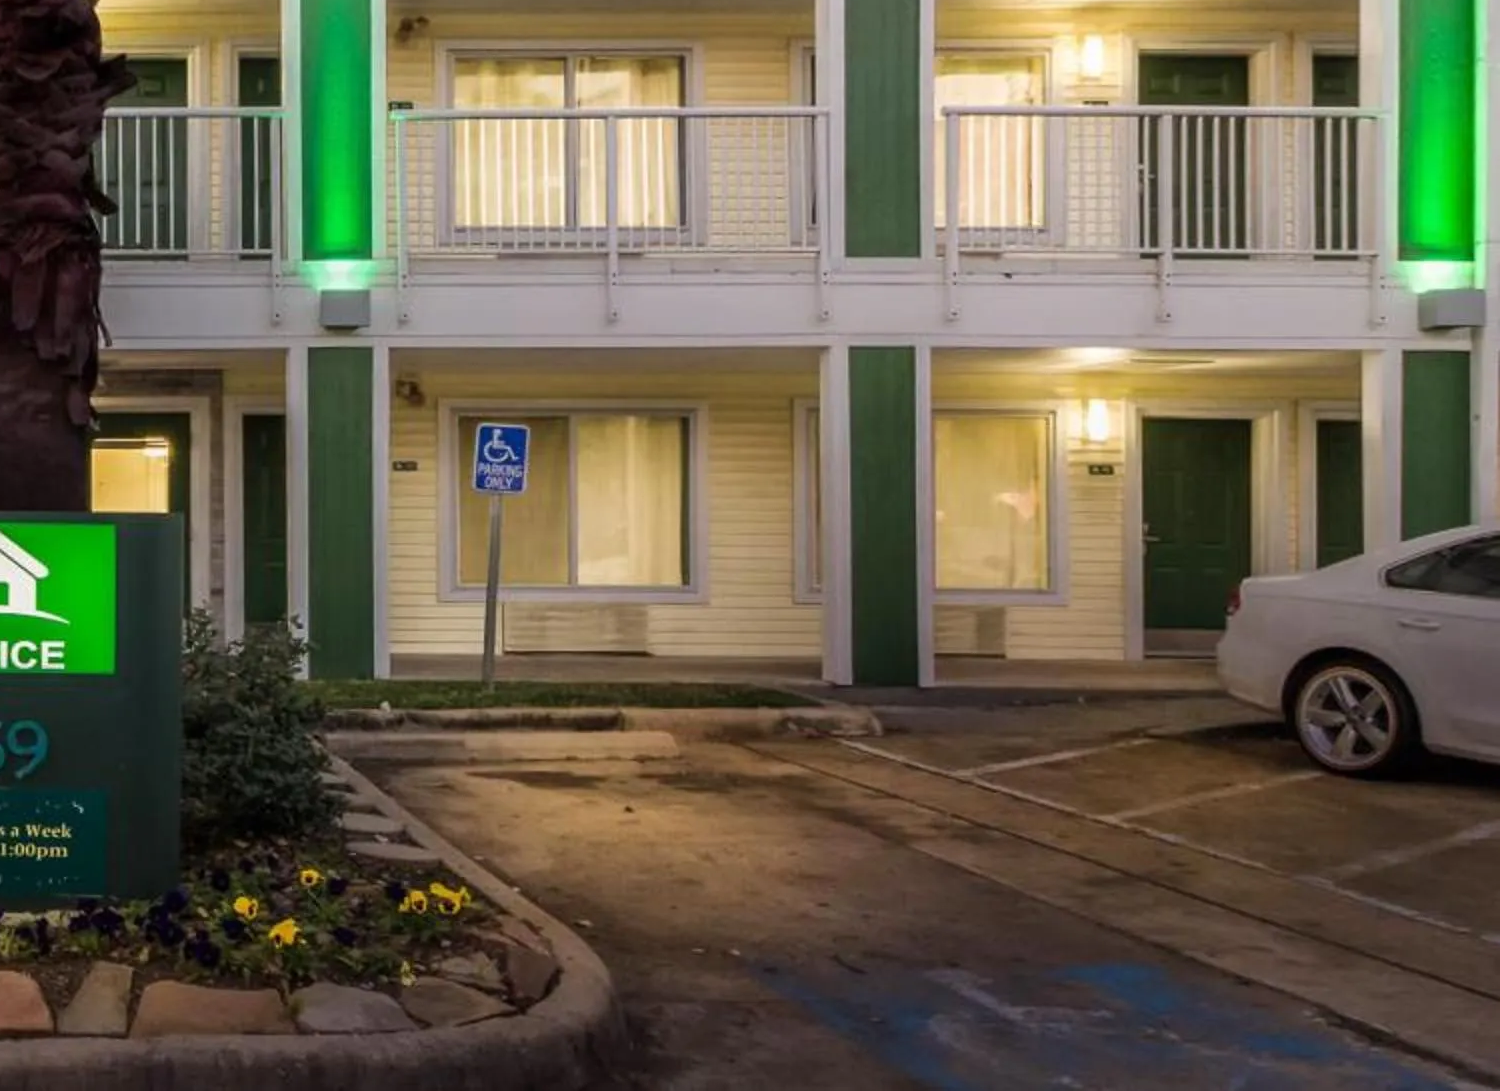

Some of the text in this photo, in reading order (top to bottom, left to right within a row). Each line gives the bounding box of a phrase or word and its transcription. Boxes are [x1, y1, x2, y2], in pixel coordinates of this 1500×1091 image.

[478, 462, 523, 478] PARKING
[485, 476, 513, 489] ONLY
[10, 826, 19, 838] a
[25, 823, 72, 839] Week
